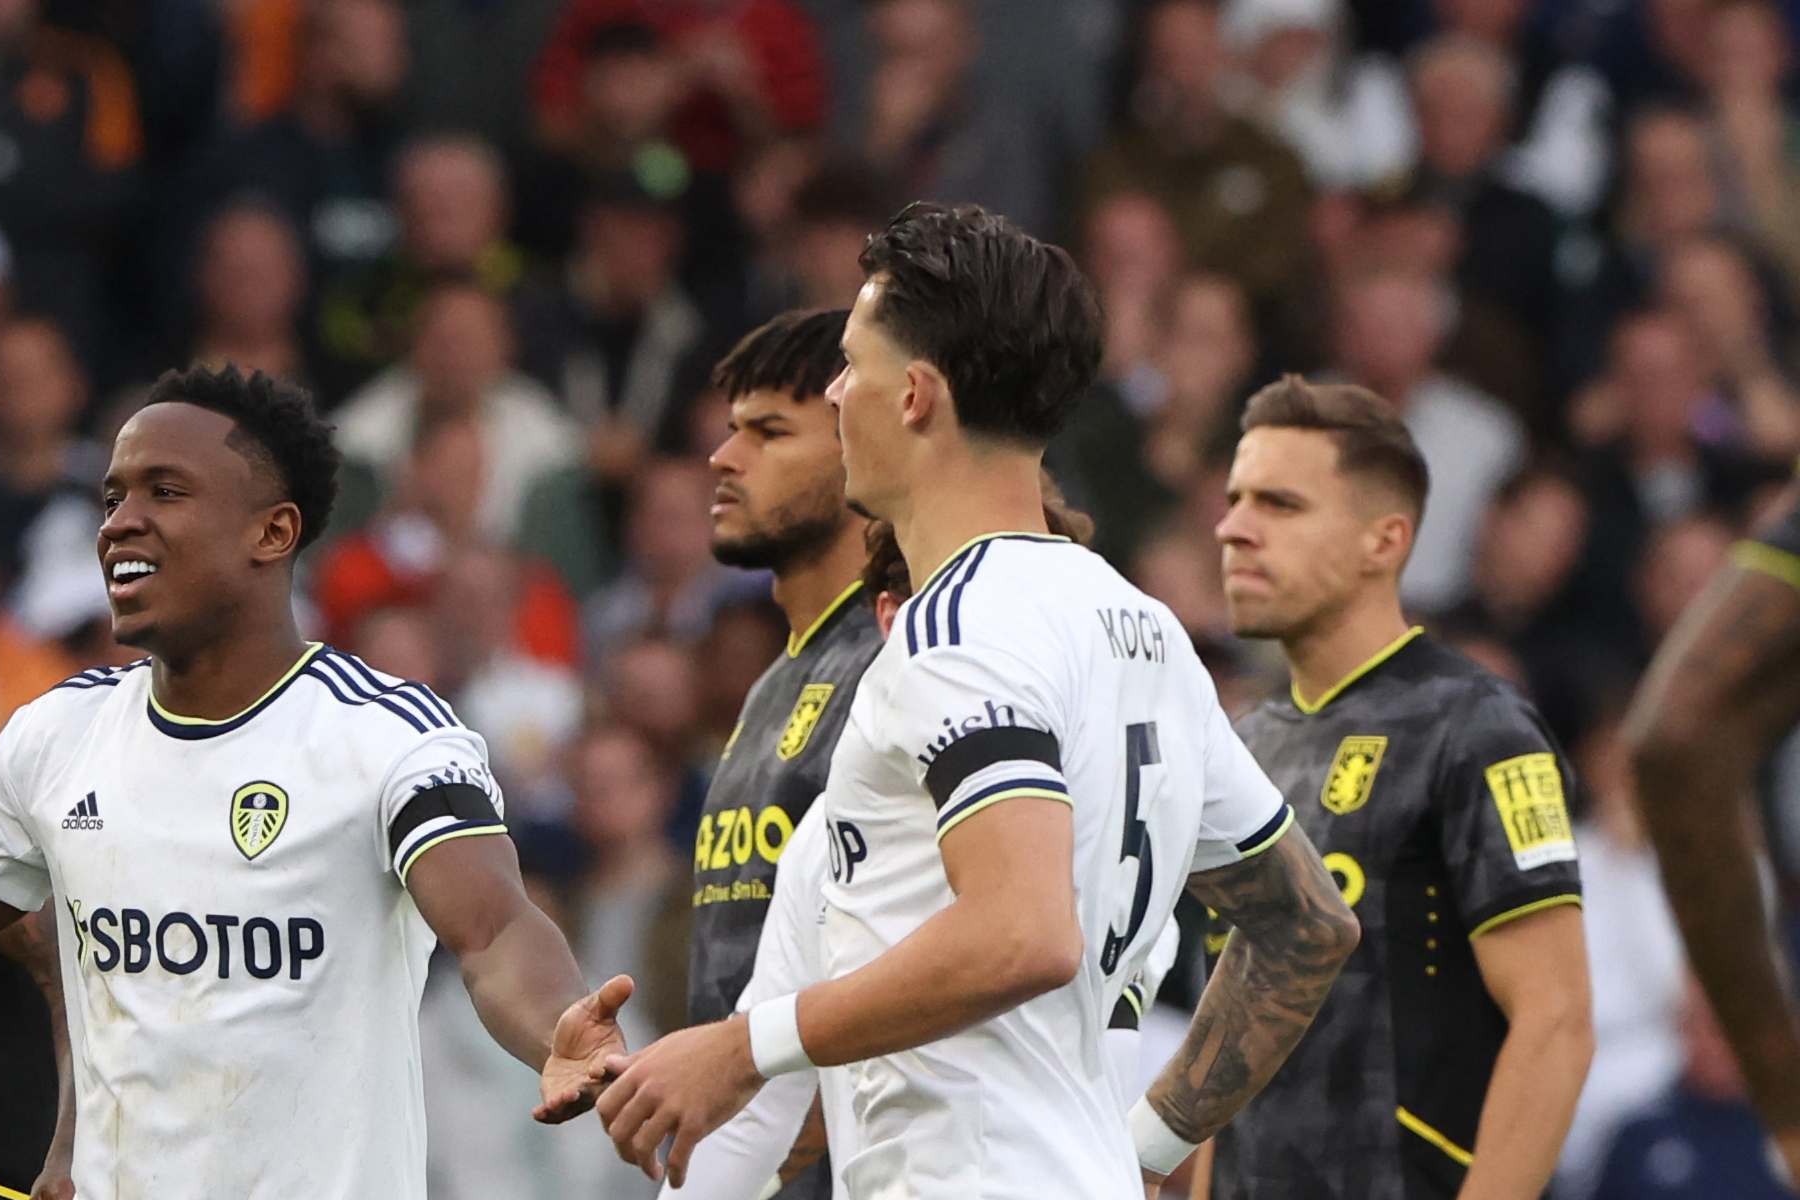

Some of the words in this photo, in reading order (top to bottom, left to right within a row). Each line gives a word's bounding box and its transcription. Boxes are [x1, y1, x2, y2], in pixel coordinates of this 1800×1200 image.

[1097, 607, 1165, 664] KOCH
[61, 815, 104, 830] adidas
[695, 805, 795, 871] AZOO
[1099, 721, 1162, 977] 5
[90, 907, 324, 980] SBOTOP
